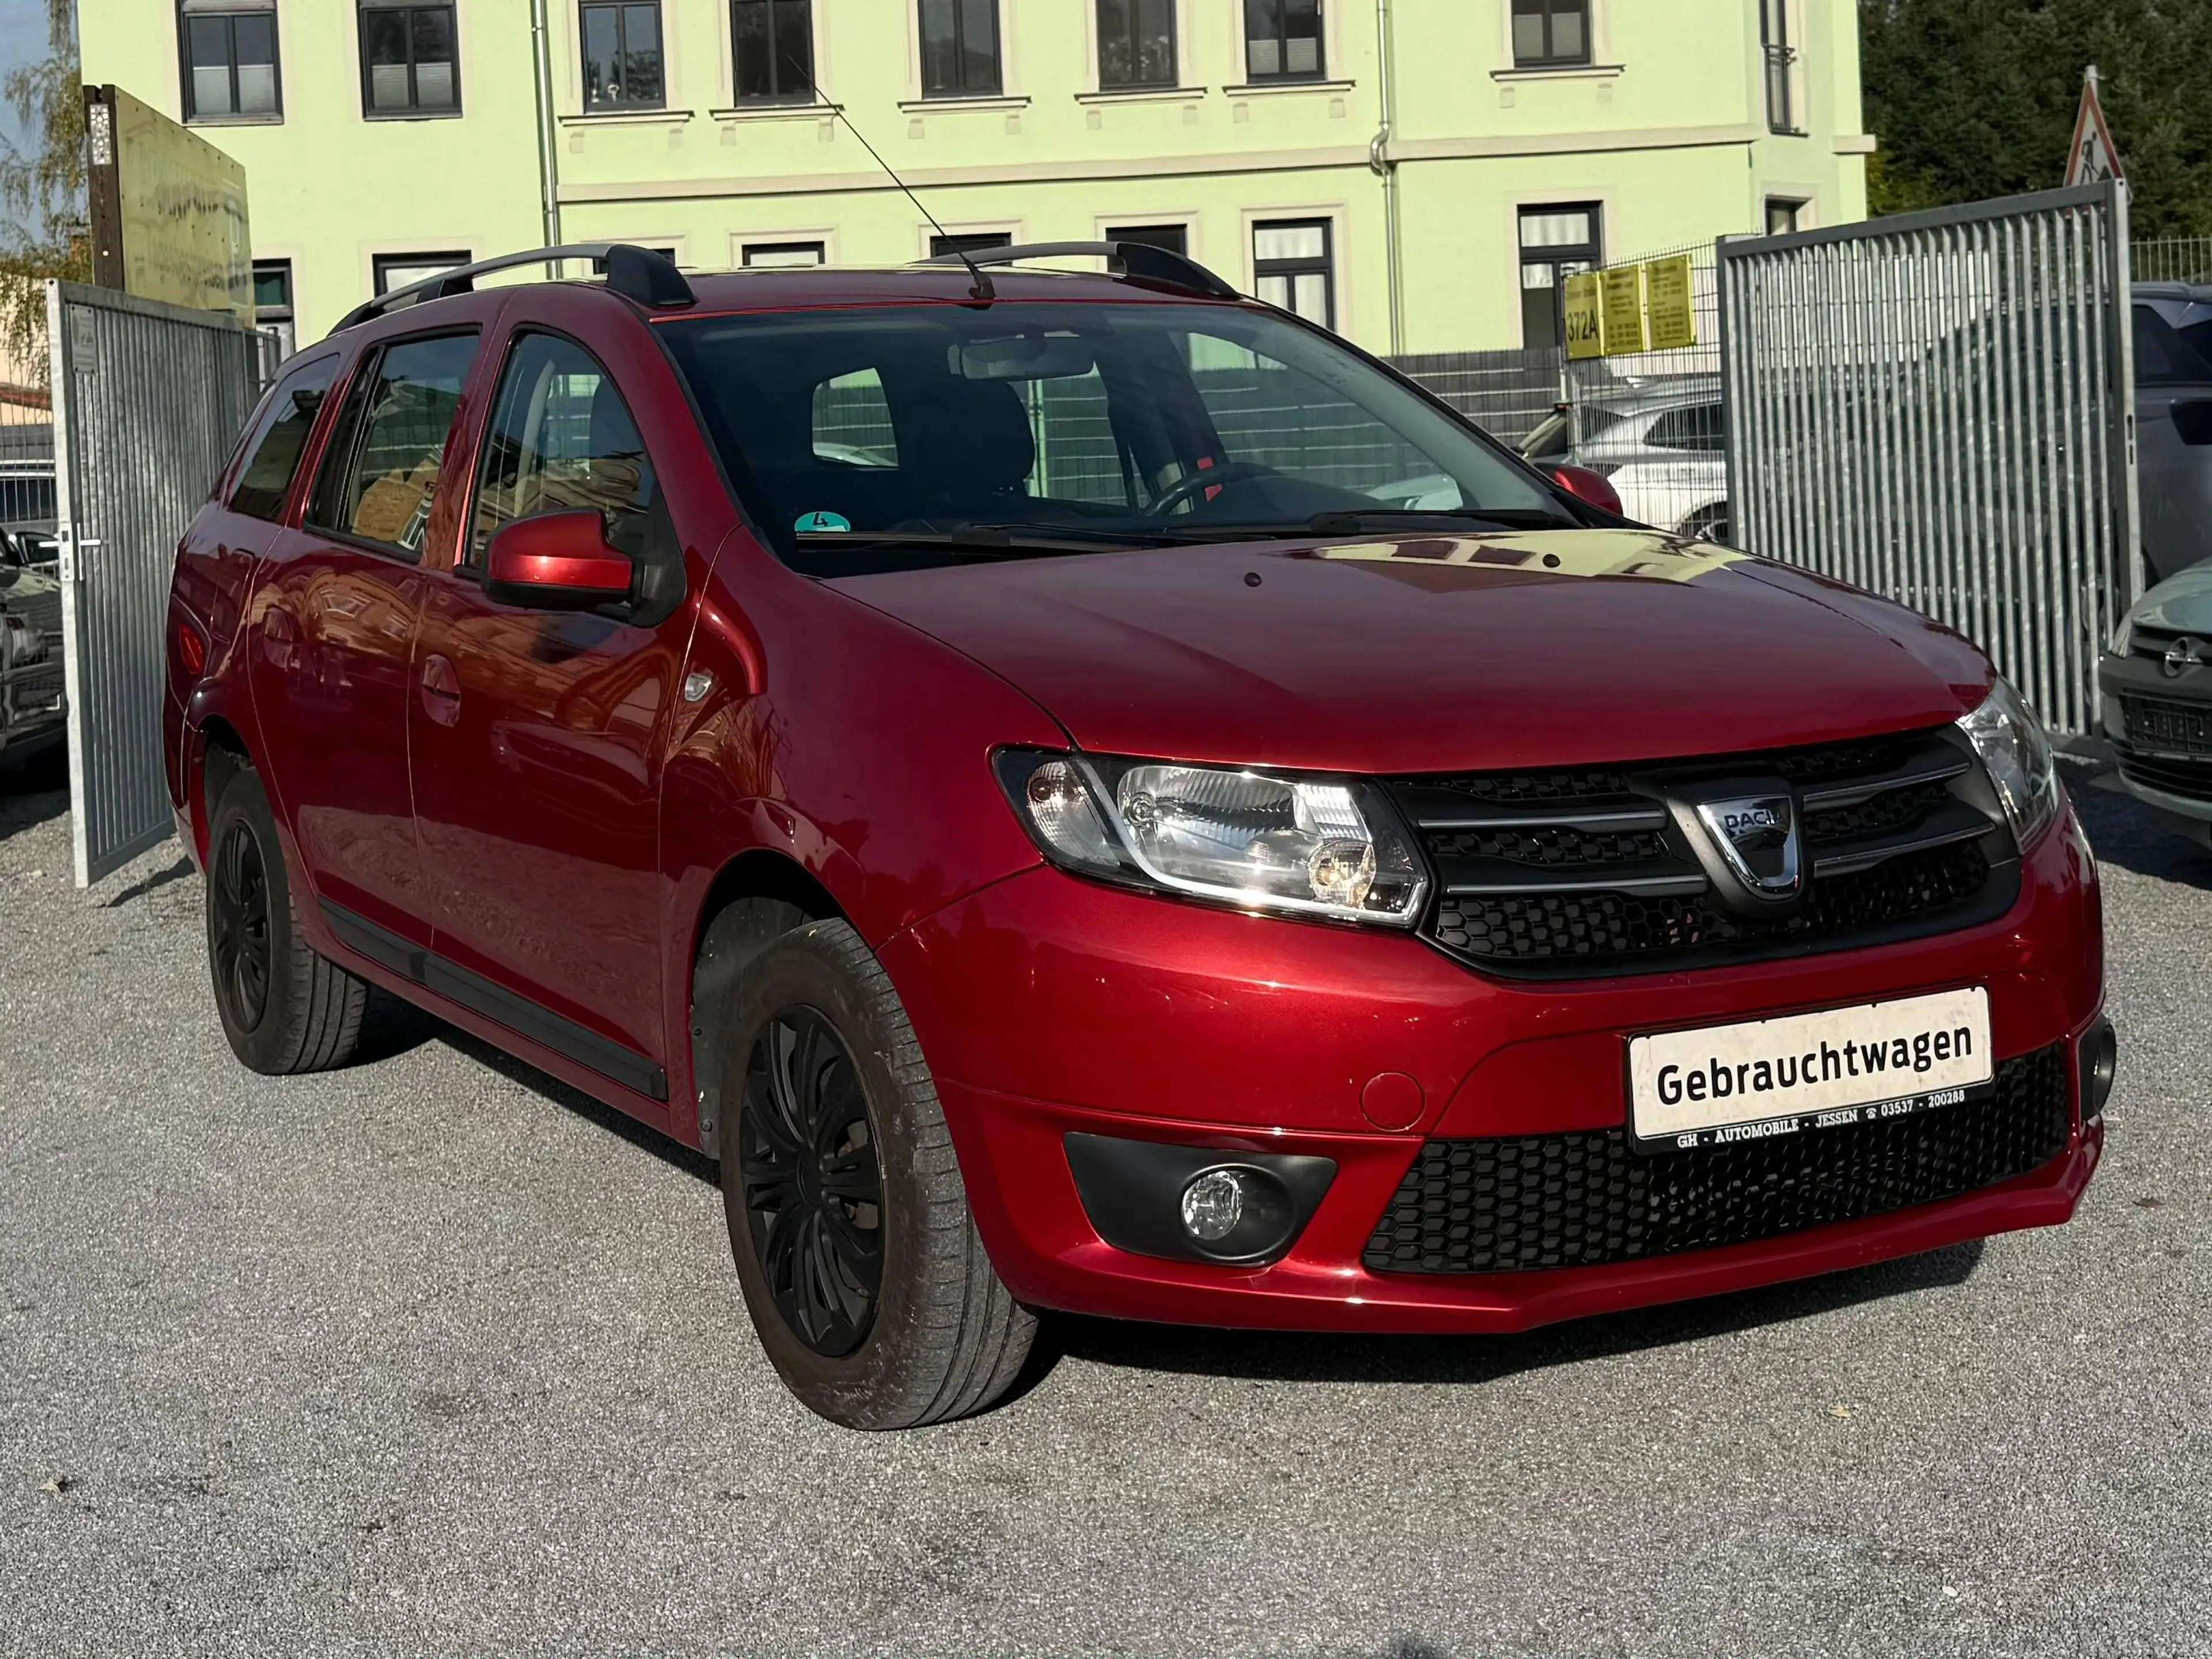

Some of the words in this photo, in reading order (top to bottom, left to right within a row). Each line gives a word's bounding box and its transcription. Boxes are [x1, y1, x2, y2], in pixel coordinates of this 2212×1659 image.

[1567, 308, 1599, 342] 372A
[812, 512, 828, 527] 4
[1657, 1026, 1972, 1105] Gebrauchtwagen
[1677, 1132, 1698, 1148] GH
[1714, 1118, 1800, 1143] AUTOMOBILE
[1815, 1109, 1858, 1128] JESSEN
[1881, 1099, 1914, 1116] 03537
[1927, 1089, 1965, 1108] 200288
